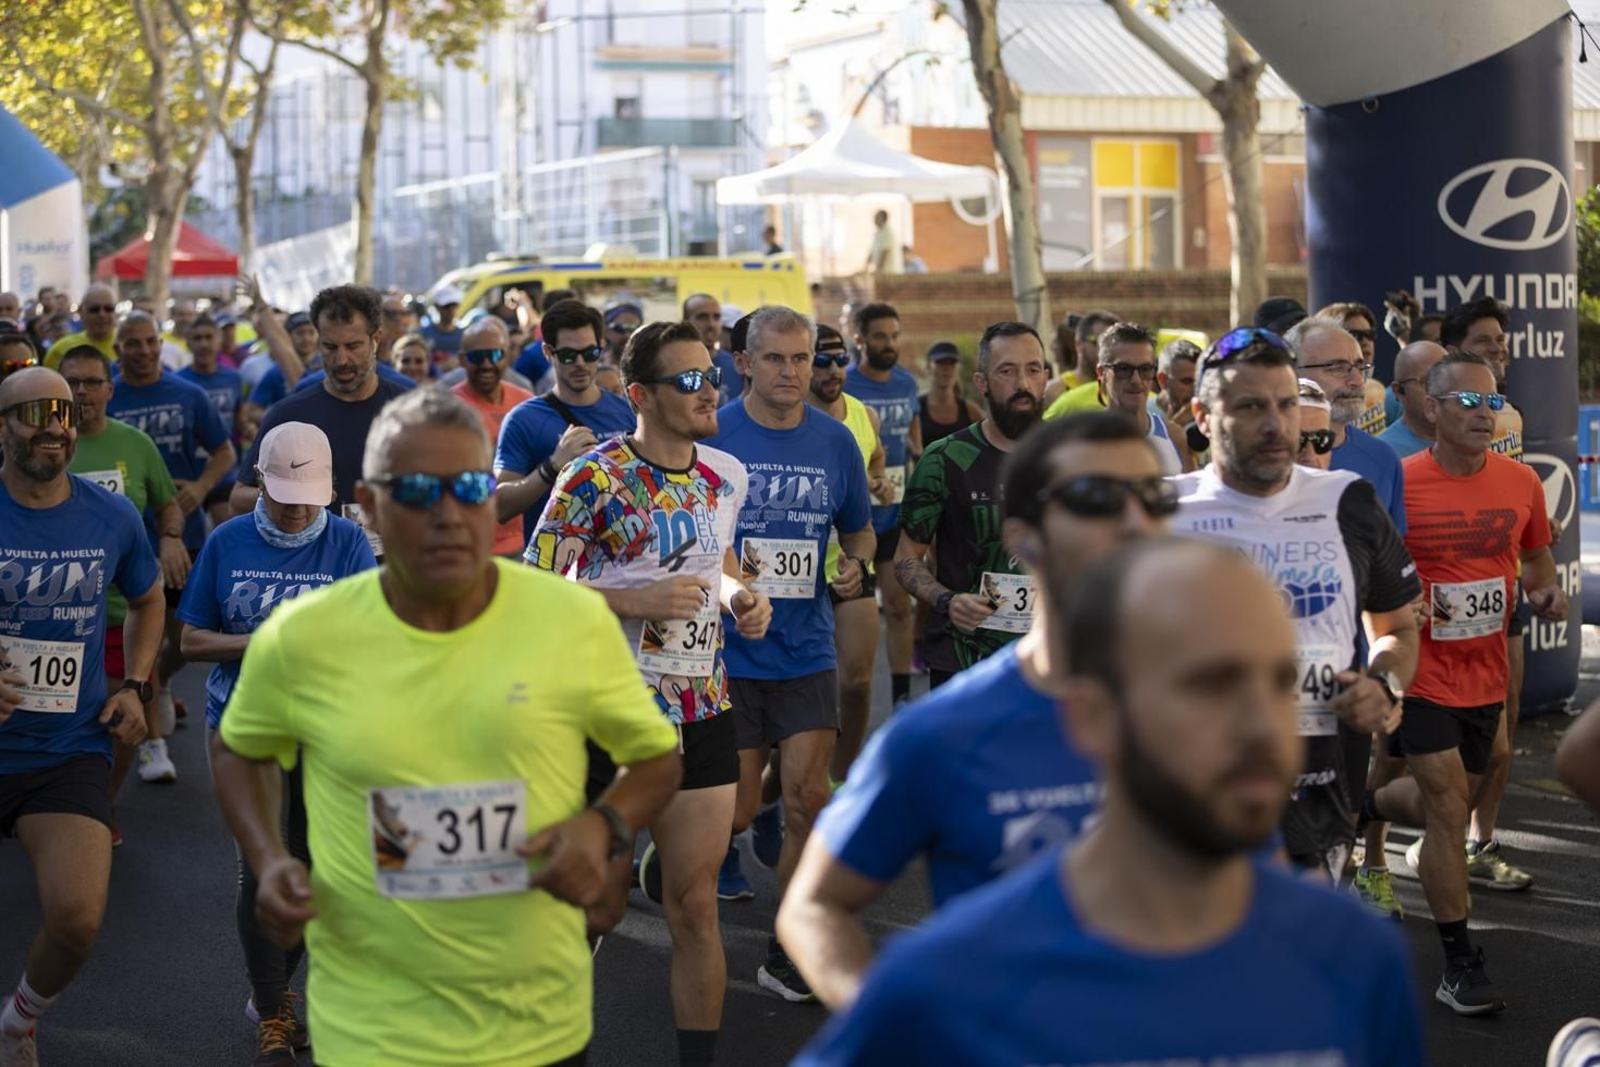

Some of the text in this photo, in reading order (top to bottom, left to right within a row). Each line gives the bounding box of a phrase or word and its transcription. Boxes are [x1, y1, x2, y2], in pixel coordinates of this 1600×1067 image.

[749, 463, 783, 472] VUELTA
[794, 466, 825, 475] HUELVA
[787, 511, 828, 525] RUNNING
[4, 549, 105, 559] VUELTA A HUELVA
[774, 552, 812, 576] 301
[245, 570, 283, 580] VUELTA
[295, 574, 334, 582] HUELVA
[1465, 590, 1503, 618] 348
[683, 621, 716, 650] 347
[30, 656, 77, 686] 109
[435, 804, 517, 855] 317
